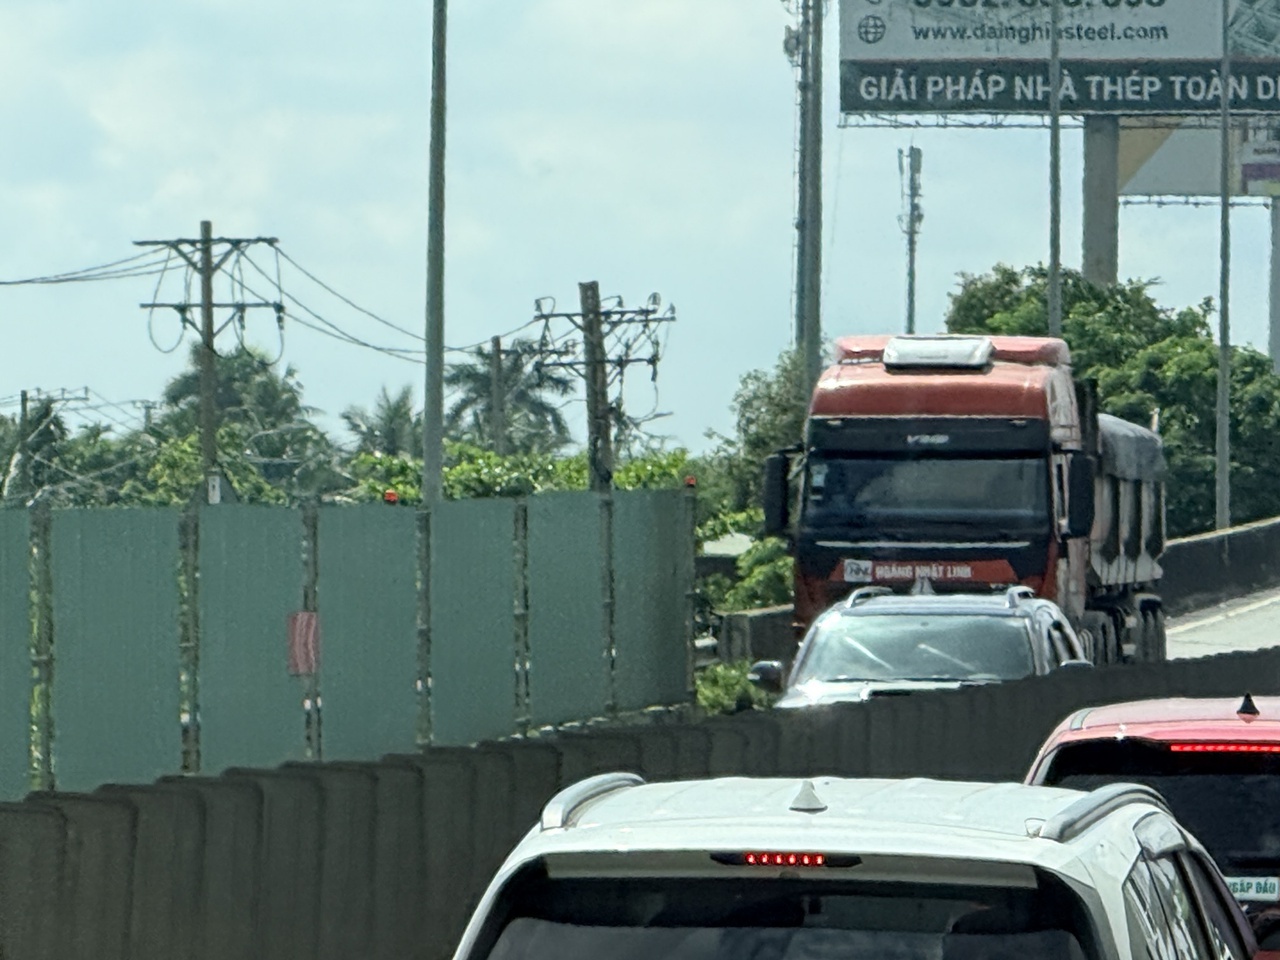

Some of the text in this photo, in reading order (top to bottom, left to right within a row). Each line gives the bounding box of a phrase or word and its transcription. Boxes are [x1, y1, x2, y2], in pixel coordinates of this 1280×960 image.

[859, 68, 918, 101] GIẢI
[926, 69, 1006, 101] PHÁP
[1086, 69, 1162, 101] THÉP
[1170, 69, 1248, 101] TOÀN
